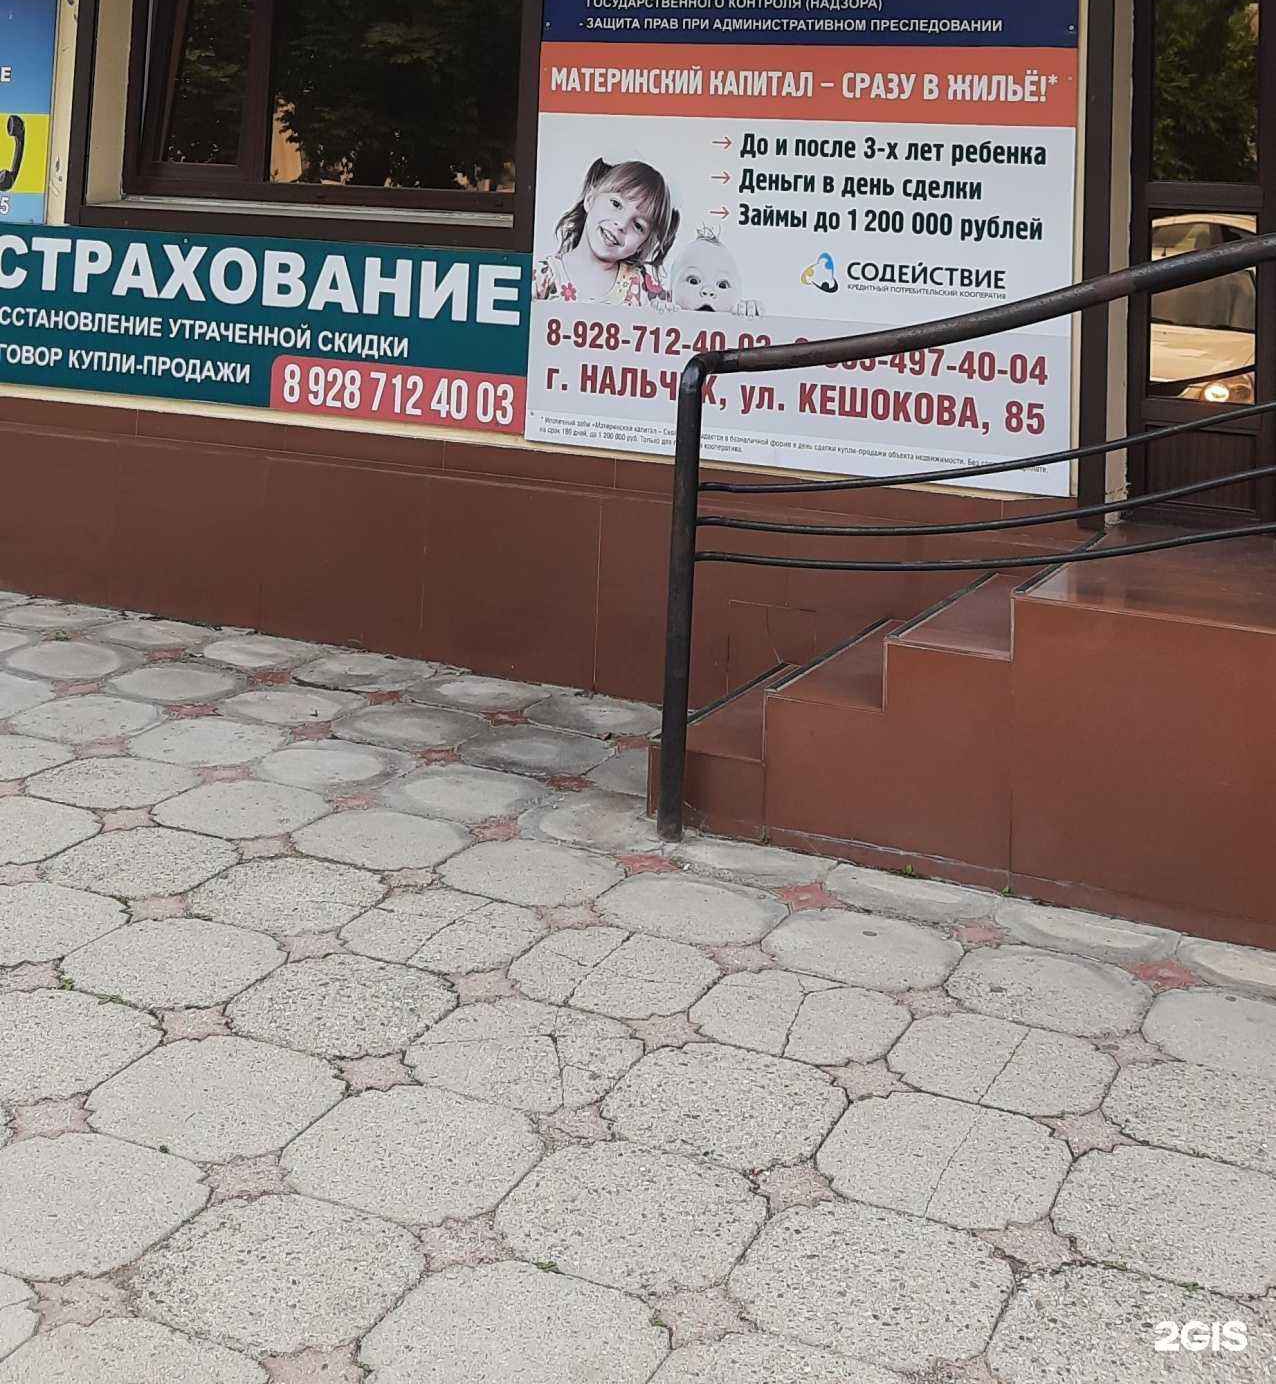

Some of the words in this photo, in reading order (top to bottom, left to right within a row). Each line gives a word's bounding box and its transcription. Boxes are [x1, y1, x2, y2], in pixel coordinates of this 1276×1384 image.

[586, 17, 640, 31] ЗАЩИТА
[644, 18, 678, 30] ПРАВ
[682, 18, 708, 30] ПРИ
[713, 19, 866, 32] АДМИНИСТРАТИВНОМ
[870, 19, 1002, 33] ПРЕСЛЕДОВАНИИ
[551, 65, 703, 95] МАТЕРИНСКИЙ
[709, 70, 813, 97] КАПИТАЛ
[842, 72, 917, 100] СРАЗУ
[923, 73, 939, 100] В
[740, 133, 769, 159] До
[775, 139, 788, 156] и
[795, 138, 857, 159] после
[864, 137, 899, 160] 3-х
[904, 142, 945, 162] лет
[951, 141, 1047, 167] ребенка
[738, 168, 815, 194] Деньги
[822, 175, 835, 194] в
[841, 175, 895, 198] день
[902, 178, 983, 201] сделки
[738, 203, 807, 229] Займы
[813, 210, 841, 232] до
[847, 208, 857, 231] 1
[864, 209, 904, 234] 200
[911, 212, 953, 236] 000
[960, 216, 1043, 242] рублей
[0, 234, 522, 327] СТРАХОВАНИЕ
[847, 261, 1006, 289] СОДЕЙСТВИЕ
[890, 285, 958, 297] ПОТРЕБИТЕЛЬСКИЙ
[959, 291, 1006, 300] КООПЕРАТИВ
[169, 318, 311, 350] УТРАЧЕННОЙ
[318, 330, 409, 359] СКИДКИ
[546, 318, 772, 356] 8-928-712-400
[68, 348, 251, 384] КУПЛИ-ПРОДАЖИ
[283, 363, 301, 403] 8
[308, 366, 361, 409] 928
[370, 371, 424, 416] 712
[430, 377, 469, 420] 40
[476, 381, 514, 425] 03
[546, 367, 568, 391] г.
[580, 363, 727, 411] НАЛЬЧК,
[740, 383, 785, 414] ул.
[799, 382, 990, 435] КЕШОКОВА,
[1004, 400, 1045, 435] 85
